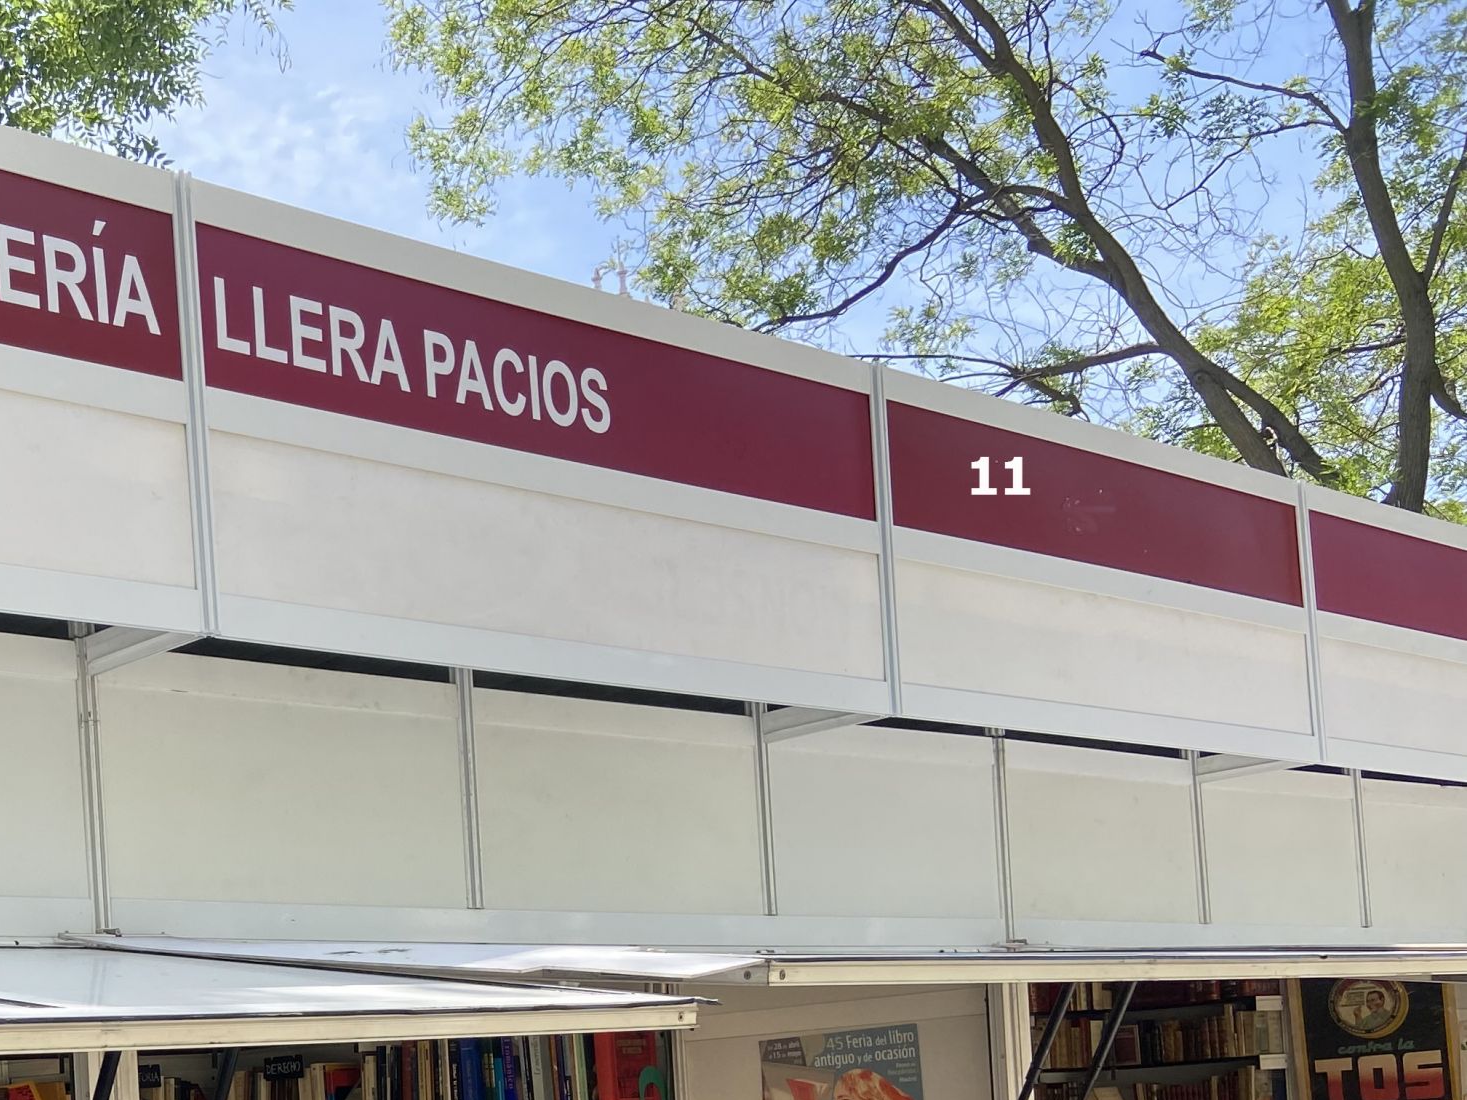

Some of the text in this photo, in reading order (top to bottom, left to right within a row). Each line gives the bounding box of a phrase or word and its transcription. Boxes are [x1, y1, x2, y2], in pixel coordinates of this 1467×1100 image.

[213, 275, 411, 393] LLERA
[423, 327, 612, 435] PACIOS
[826, 1031, 914, 1050] 45 Feria del libro
[1337, 1038, 1415, 1055] contra la
[814, 1046, 916, 1069] antiguo y de ocasión
[266, 1061, 301, 1075] DERECHO
